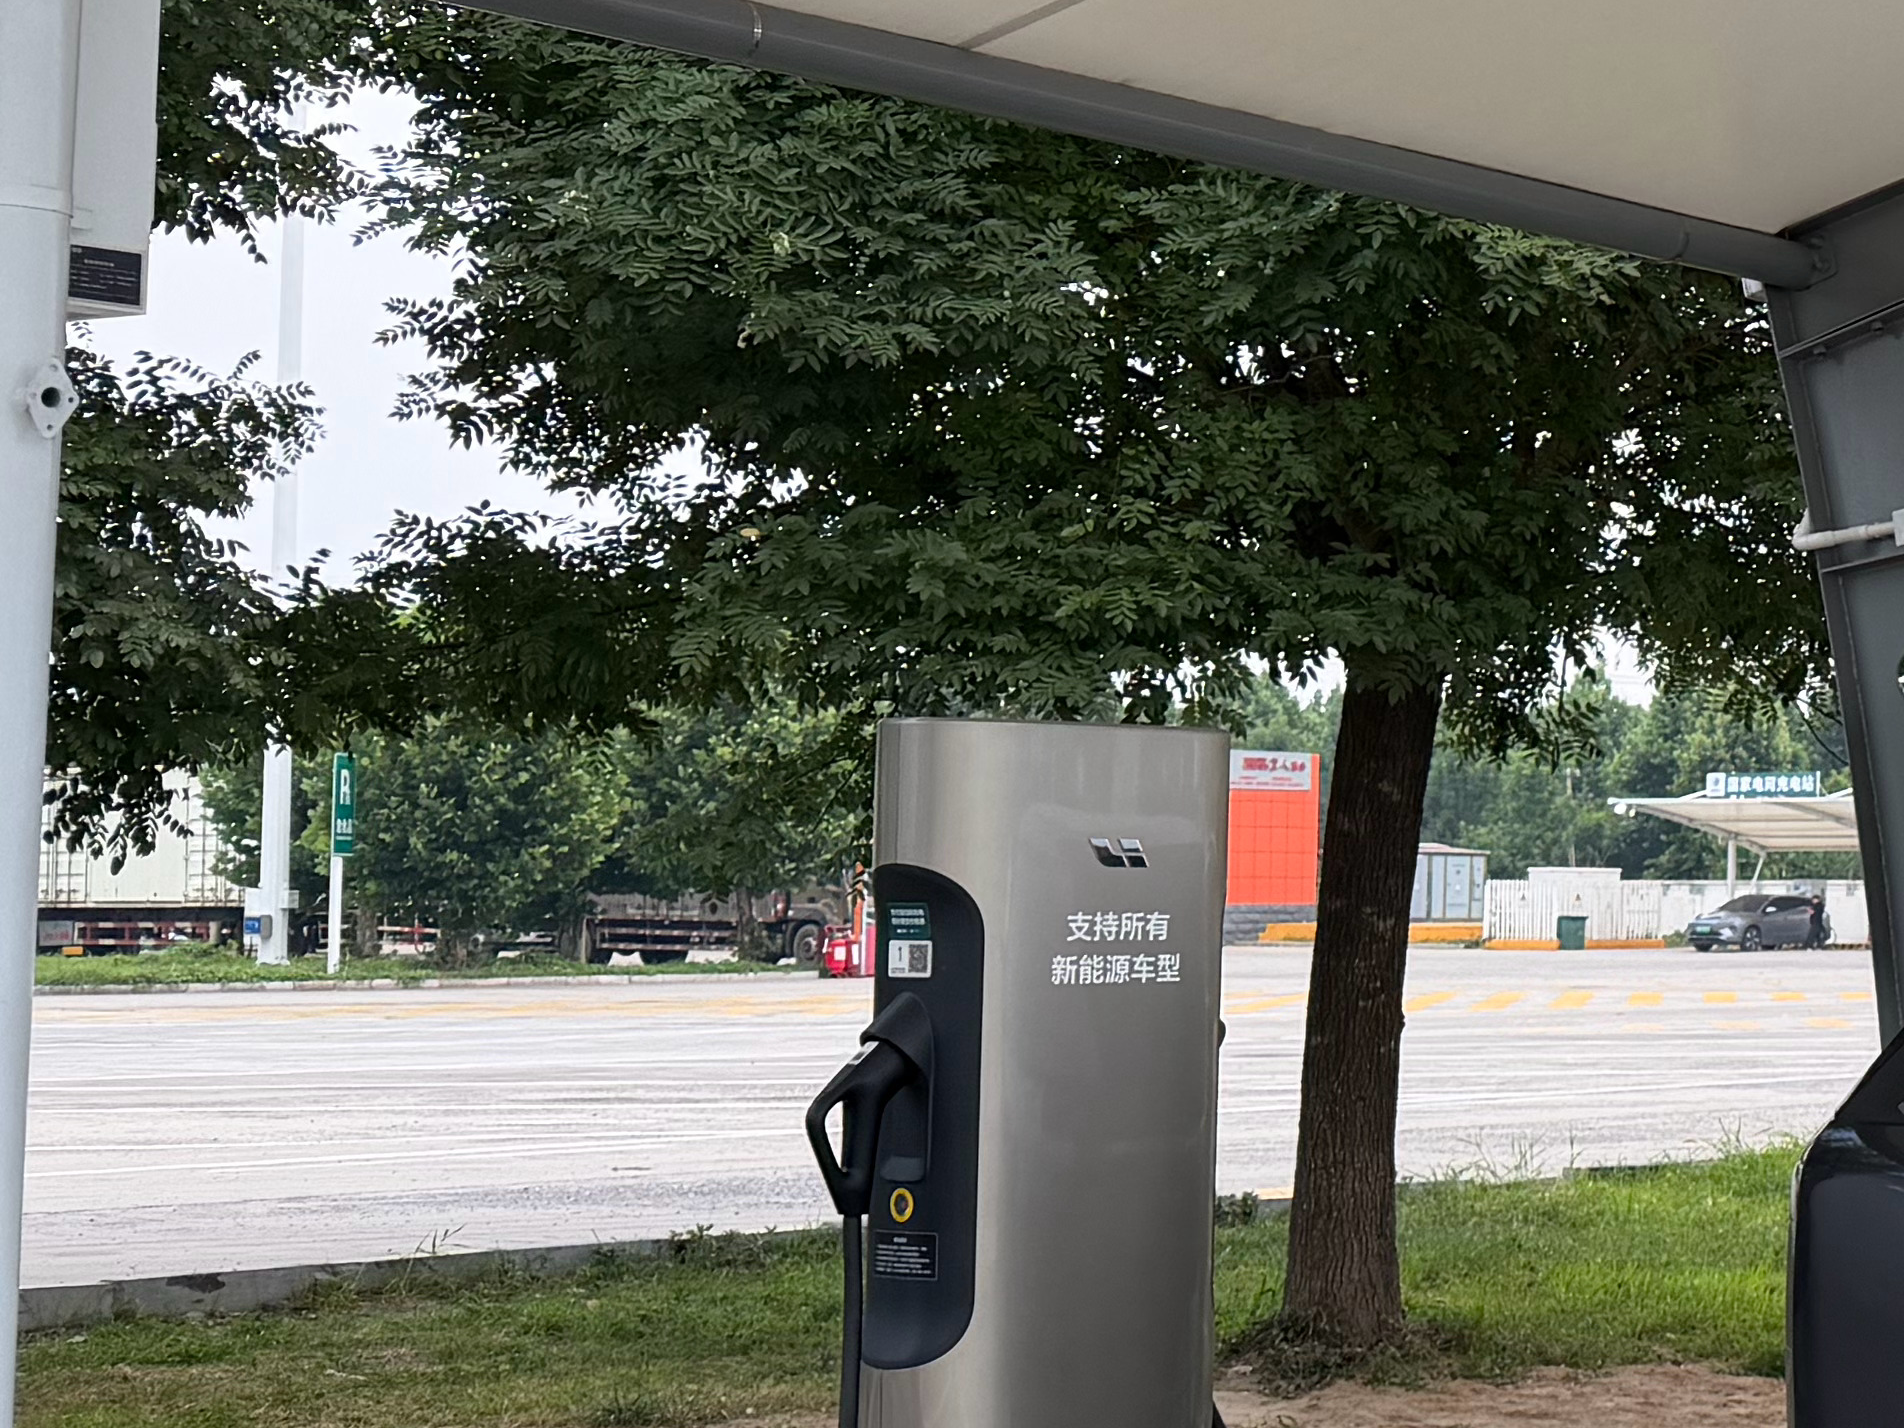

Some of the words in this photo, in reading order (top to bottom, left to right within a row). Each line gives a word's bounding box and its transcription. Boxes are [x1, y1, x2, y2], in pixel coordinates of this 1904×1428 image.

[1066, 911, 1171, 942] 支持所有
[1051, 953, 1181, 985] 新能源车型
